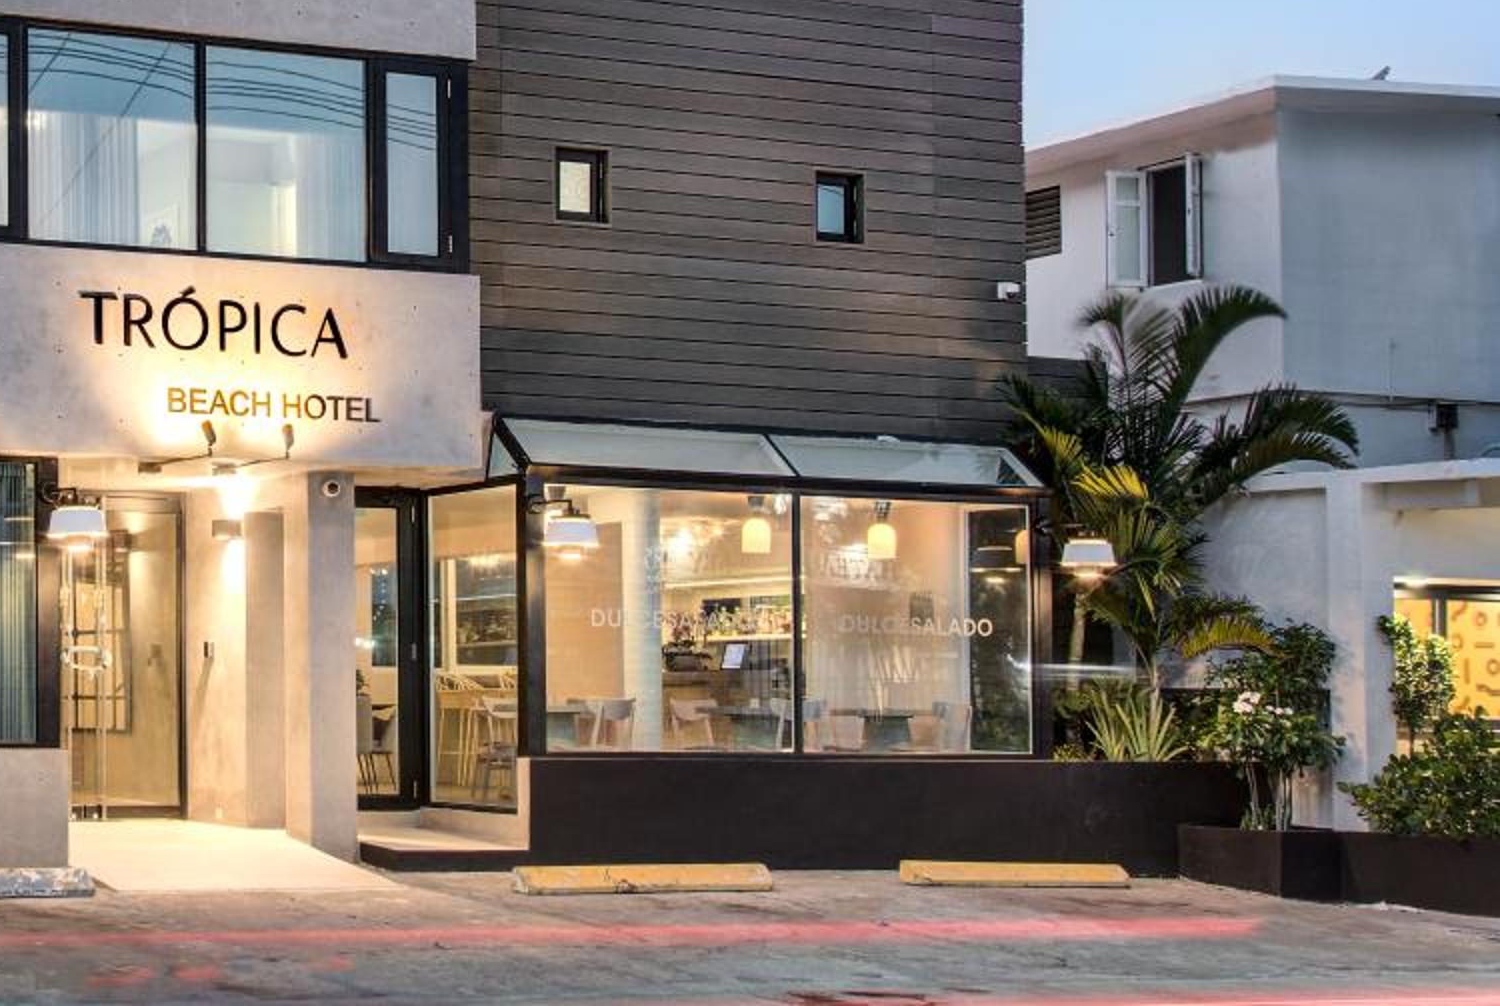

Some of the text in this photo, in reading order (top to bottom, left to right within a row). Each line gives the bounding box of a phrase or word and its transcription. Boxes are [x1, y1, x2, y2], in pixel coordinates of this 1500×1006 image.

[78, 285, 348, 359] TRÓPICA
[167, 387, 381, 423] BEACH HOTEL
[590, 608, 753, 632] DUCESAA
